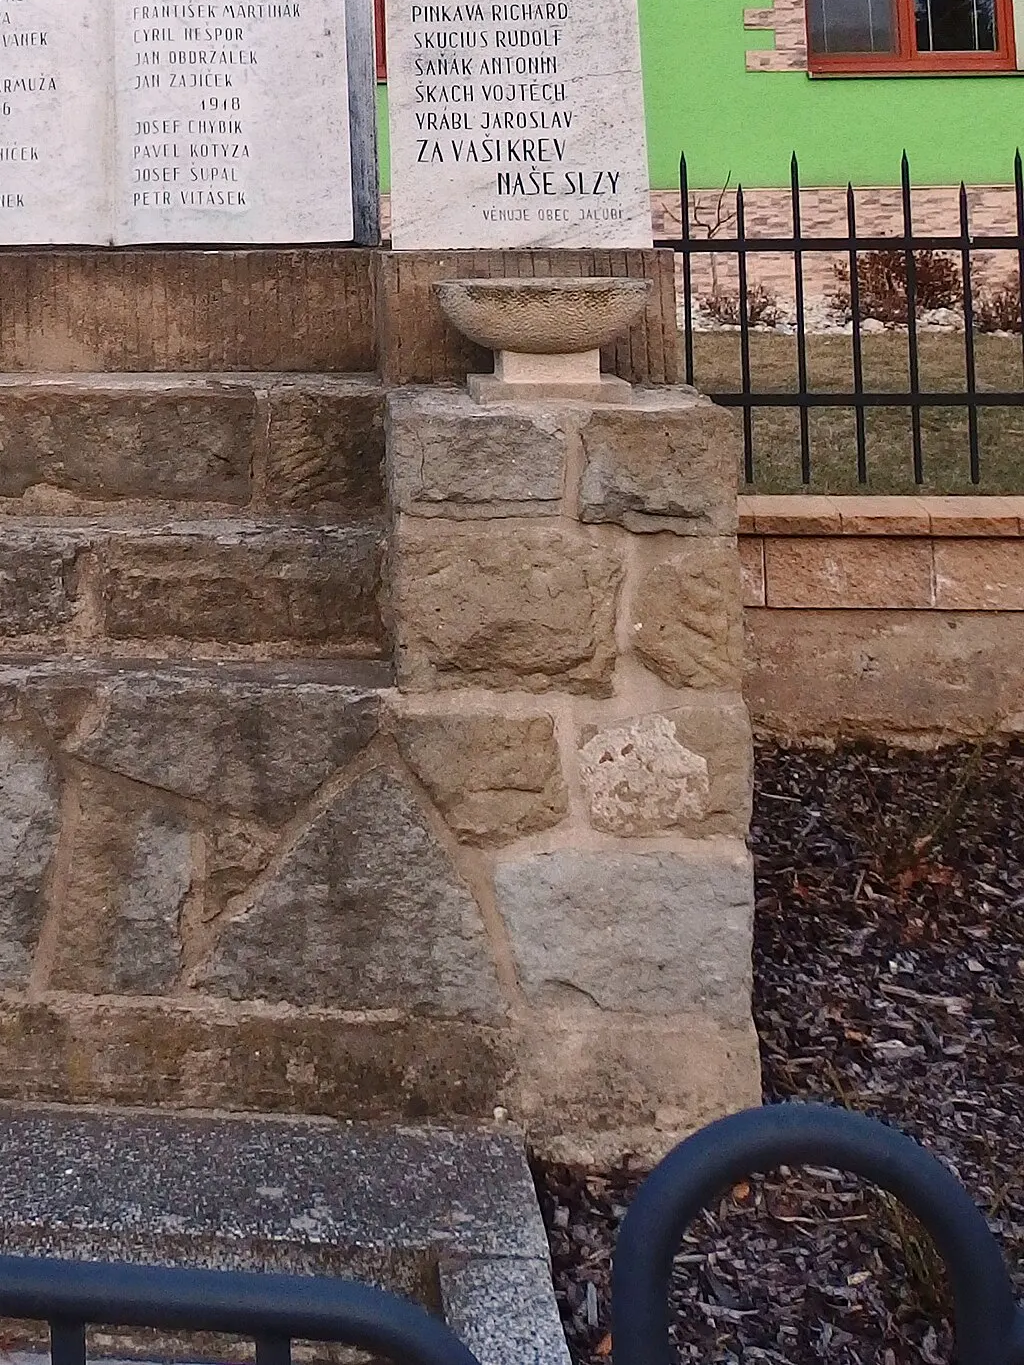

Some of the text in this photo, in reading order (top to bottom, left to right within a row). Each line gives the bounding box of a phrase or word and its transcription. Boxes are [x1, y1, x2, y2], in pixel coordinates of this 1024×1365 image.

[133, 0, 216, 20] FRANTIŠEK
[412, 2, 568, 22] PINKAVA RICHARD
[133, 21, 244, 44] CYRIL NEŠPOR
[414, 29, 562, 49] SKUCIUS RUDOLF
[134, 51, 160, 66] JAN
[415, 51, 557, 76] ŠAŇÁK ANTONÍN
[134, 74, 160, 89] JAN
[415, 78, 566, 103] ŠKACH VOJTĚCH
[201, 97, 241, 111] 1918
[134, 114, 243, 135] JOSEF CHYBÍK
[416, 106, 573, 130] VRÁBL JAROSLAV
[133, 144, 250, 159] PAVEL KOTYZA
[416, 133, 566, 163] ZA VAŠI KREV
[134, 168, 180, 183] JOSEF
[497, 166, 620, 196] NAŠE SLZY
[133, 191, 171, 207] PETR
[538, 209, 569, 221] OBEC
